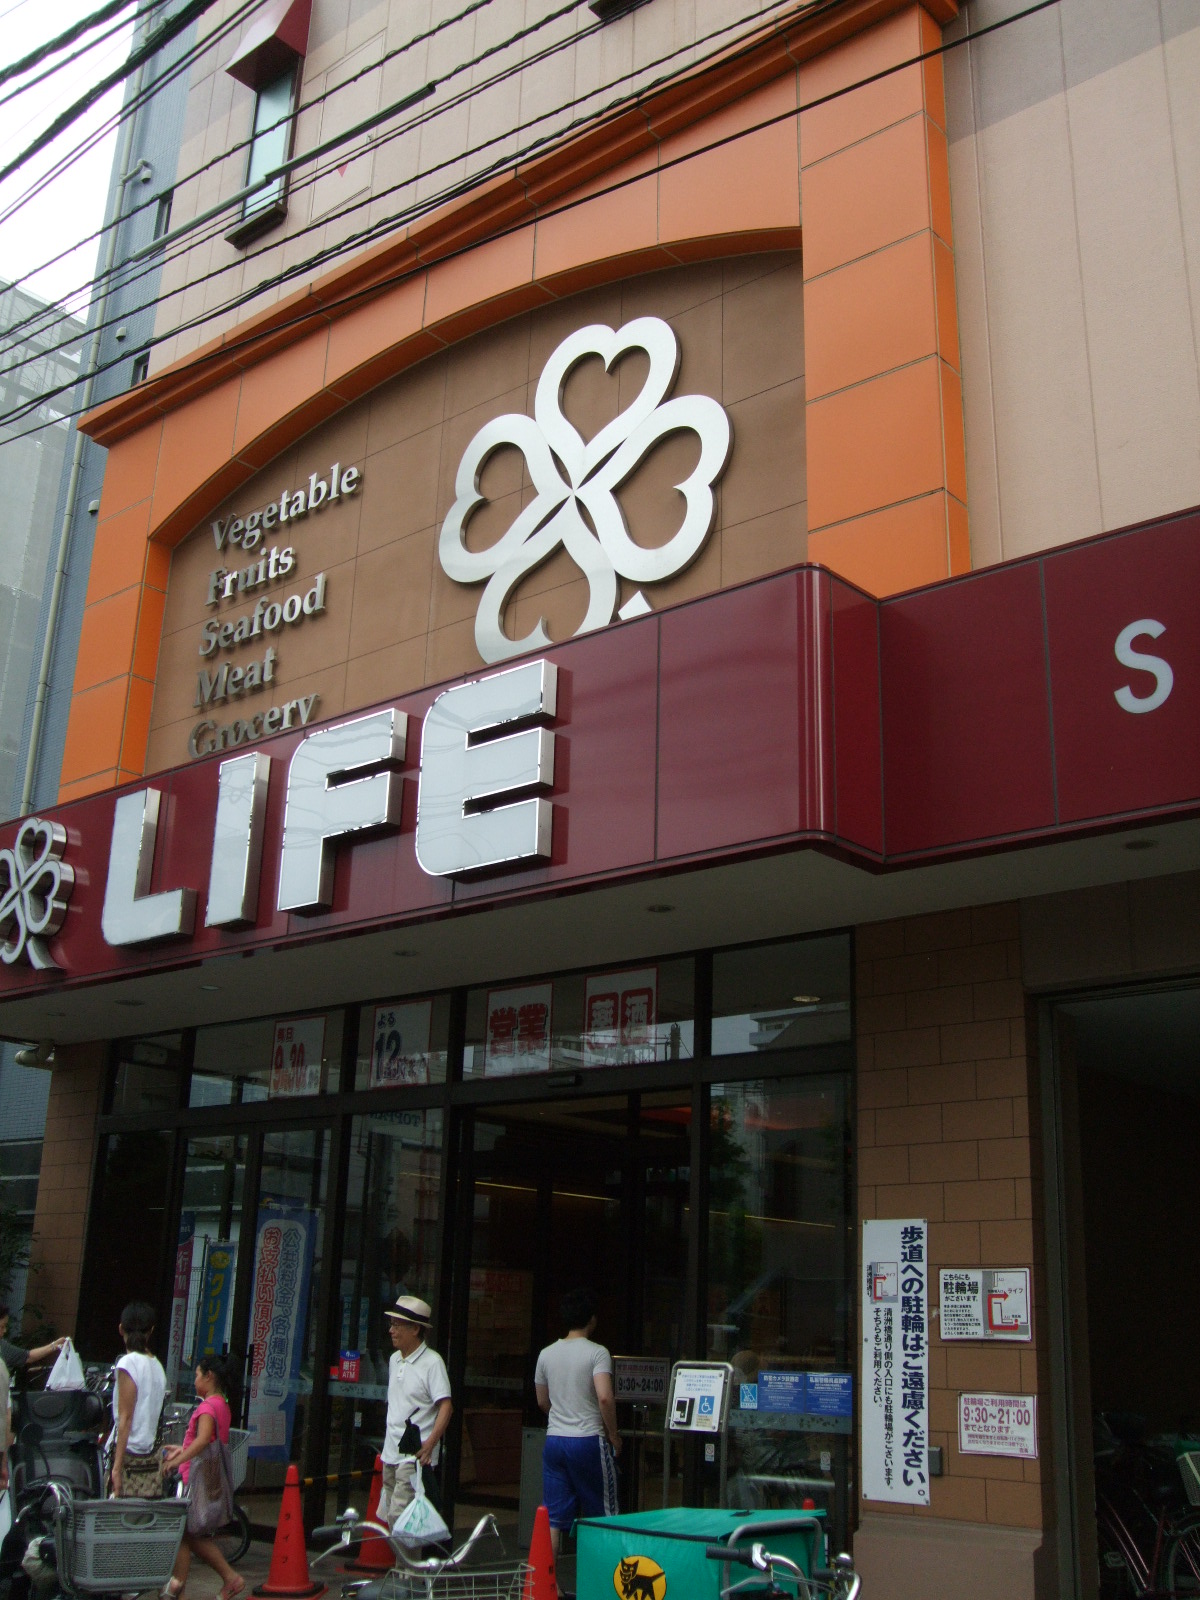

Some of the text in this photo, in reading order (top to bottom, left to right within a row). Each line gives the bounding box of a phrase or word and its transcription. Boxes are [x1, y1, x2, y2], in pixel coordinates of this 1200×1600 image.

[211, 462, 360, 550] Vegetable
[205, 546, 296, 607] Fruits
[198, 572, 327, 657] Seafood
[192, 646, 277, 709] Meat
[1113, 618, 1174, 714] S
[188, 693, 320, 760] Grocery
[101, 658, 557, 948] LIFE
[489, 1002, 549, 1058] 営業
[943, 1273, 971, 1281] こちらにも
[943, 1281, 979, 1295] 駐輪場
[342, 1361, 357, 1371] 銀行
[342, 1371, 356, 1379] ATM
[873, 1307, 882, 1408] そちらもご利用ください。
[900, 1225, 927, 1498] 歩道への駐輪はご遠慮ください。
[963, 1397, 1027, 1408] 駐輪場ご利用時間は
[963, 1424, 1014, 1435] までとなります。
